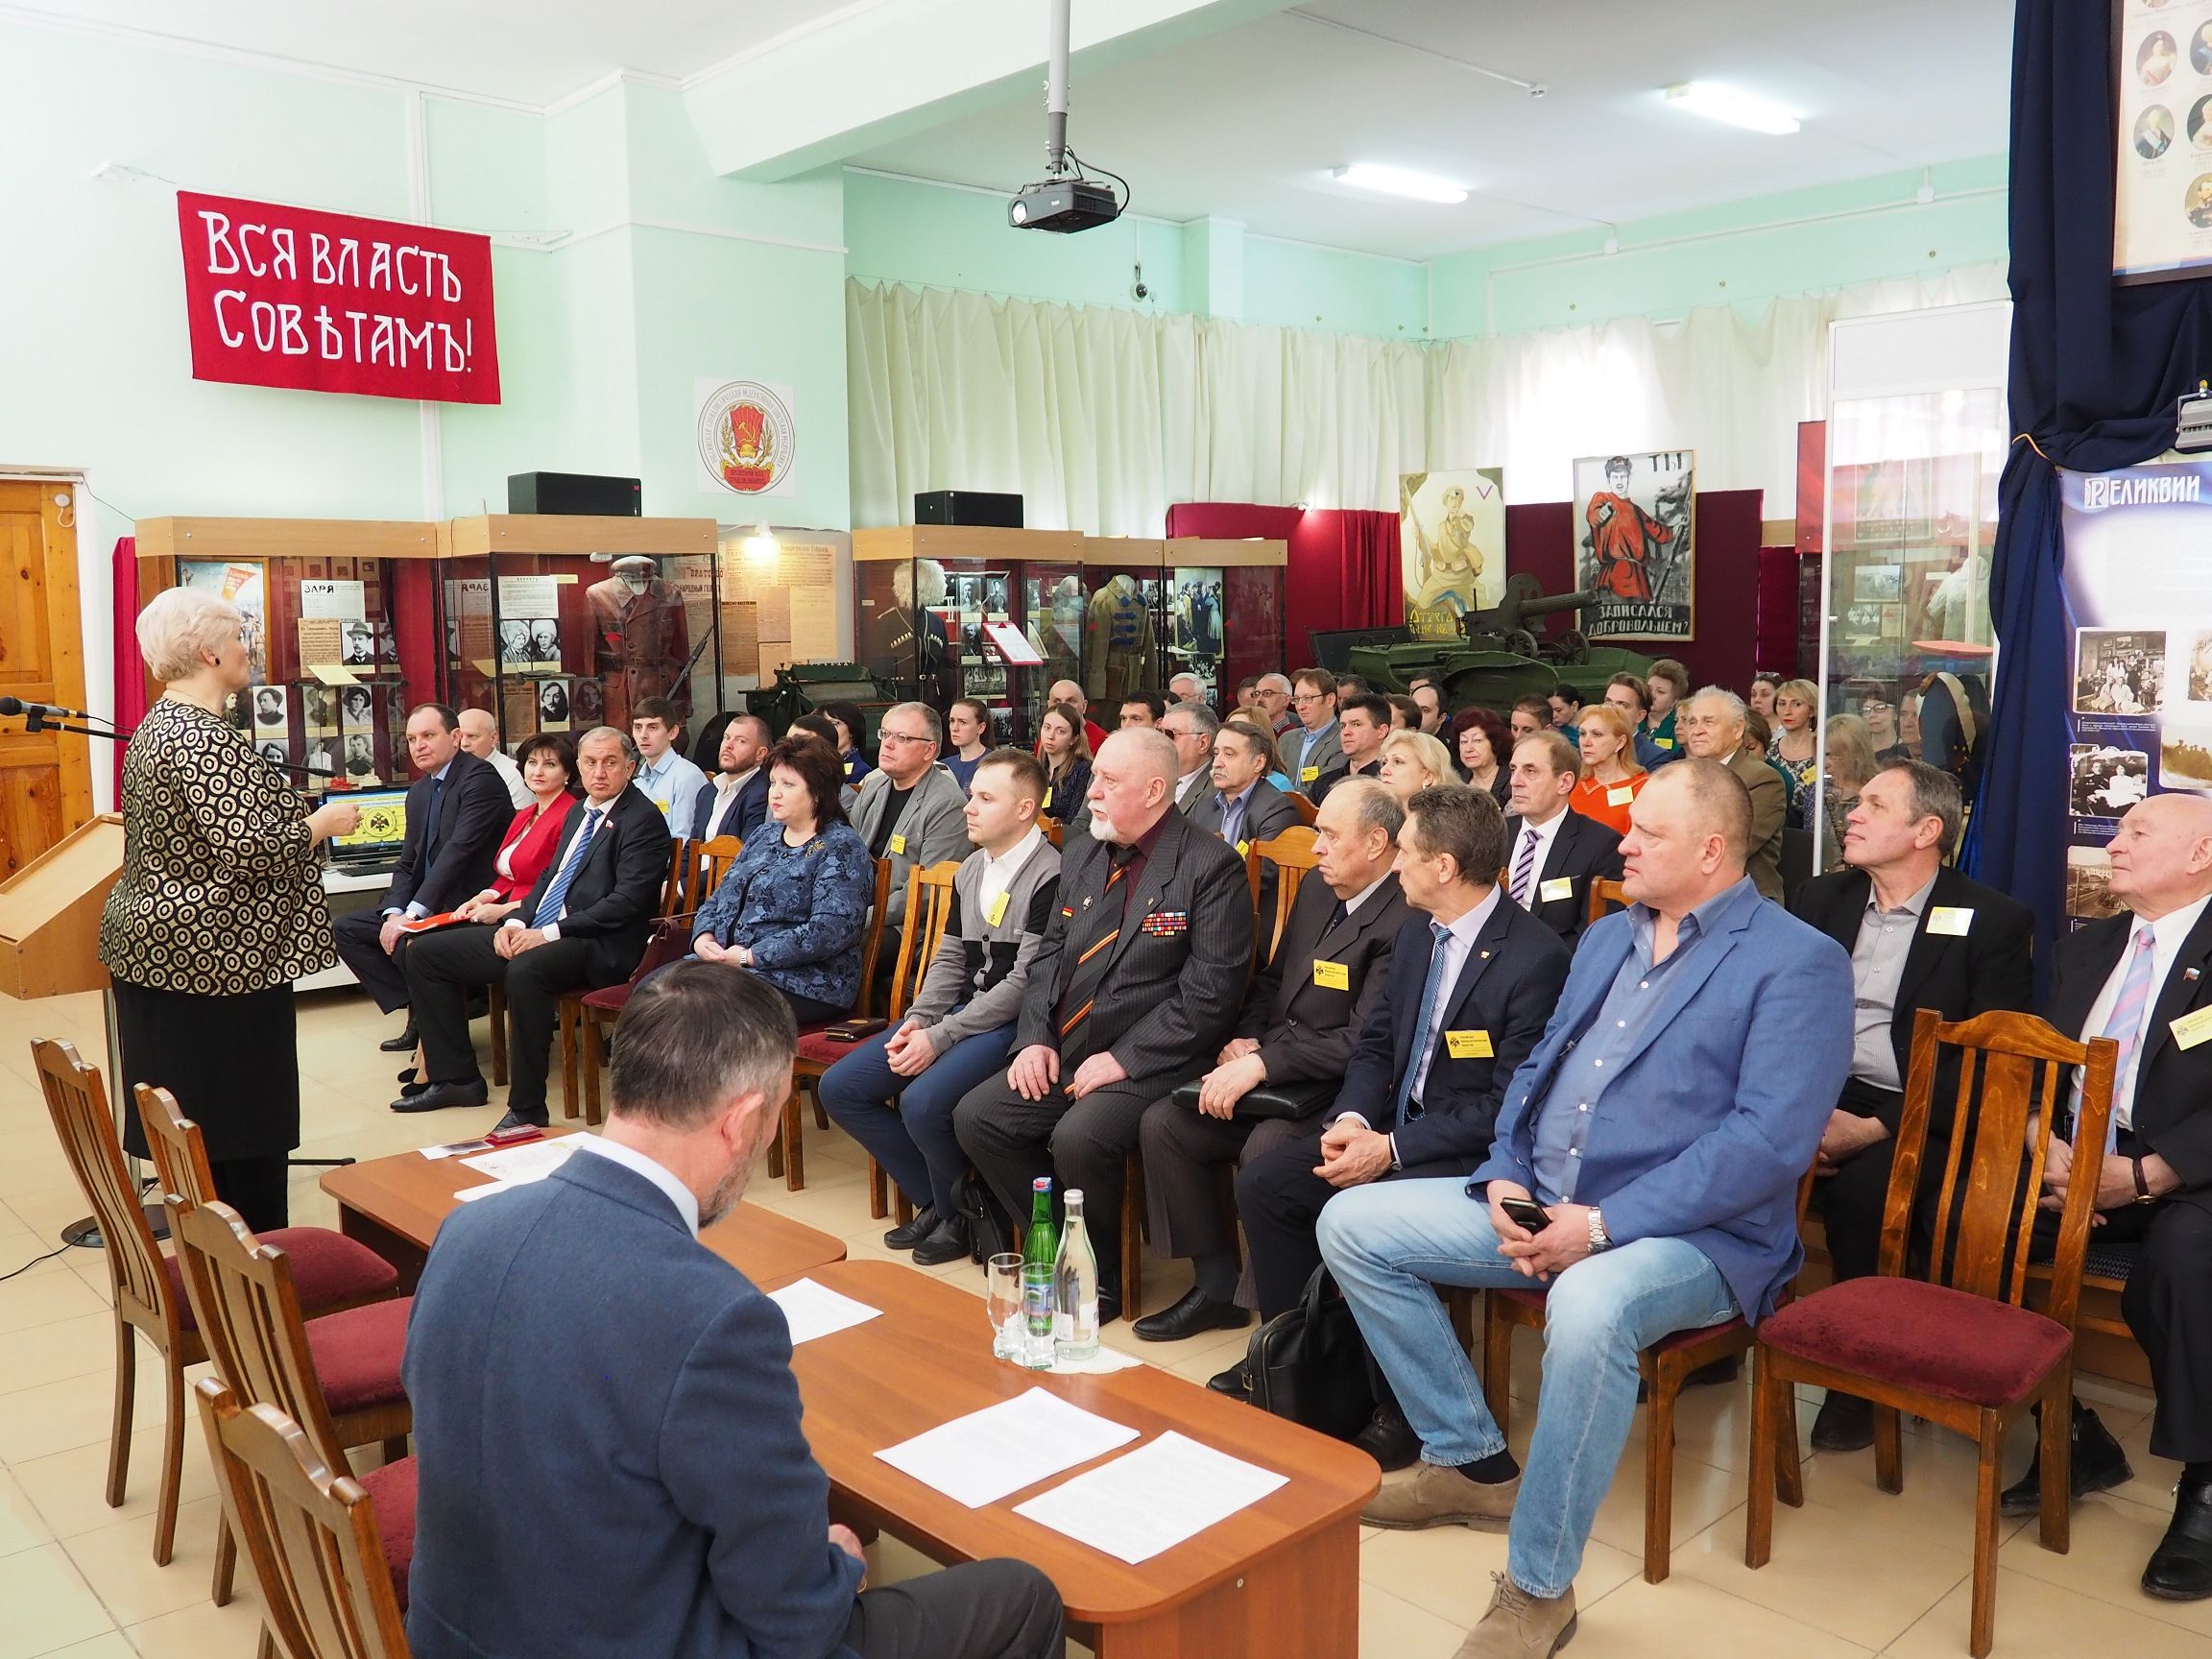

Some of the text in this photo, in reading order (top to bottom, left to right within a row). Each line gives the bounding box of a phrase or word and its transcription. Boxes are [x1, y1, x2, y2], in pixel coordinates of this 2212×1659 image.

[198, 210, 298, 280] ВСЯ
[1648, 452, 1682, 472] ТЫ
[2084, 475, 2200, 508] РЕЛИКВИИ
[304, 585, 334, 593] ЗАРЯ
[1599, 605, 1672, 619] ЗАПИСАЛСЯ
[1588, 619, 1689, 637] ДОБРОВОЛЬЦЕМ?
